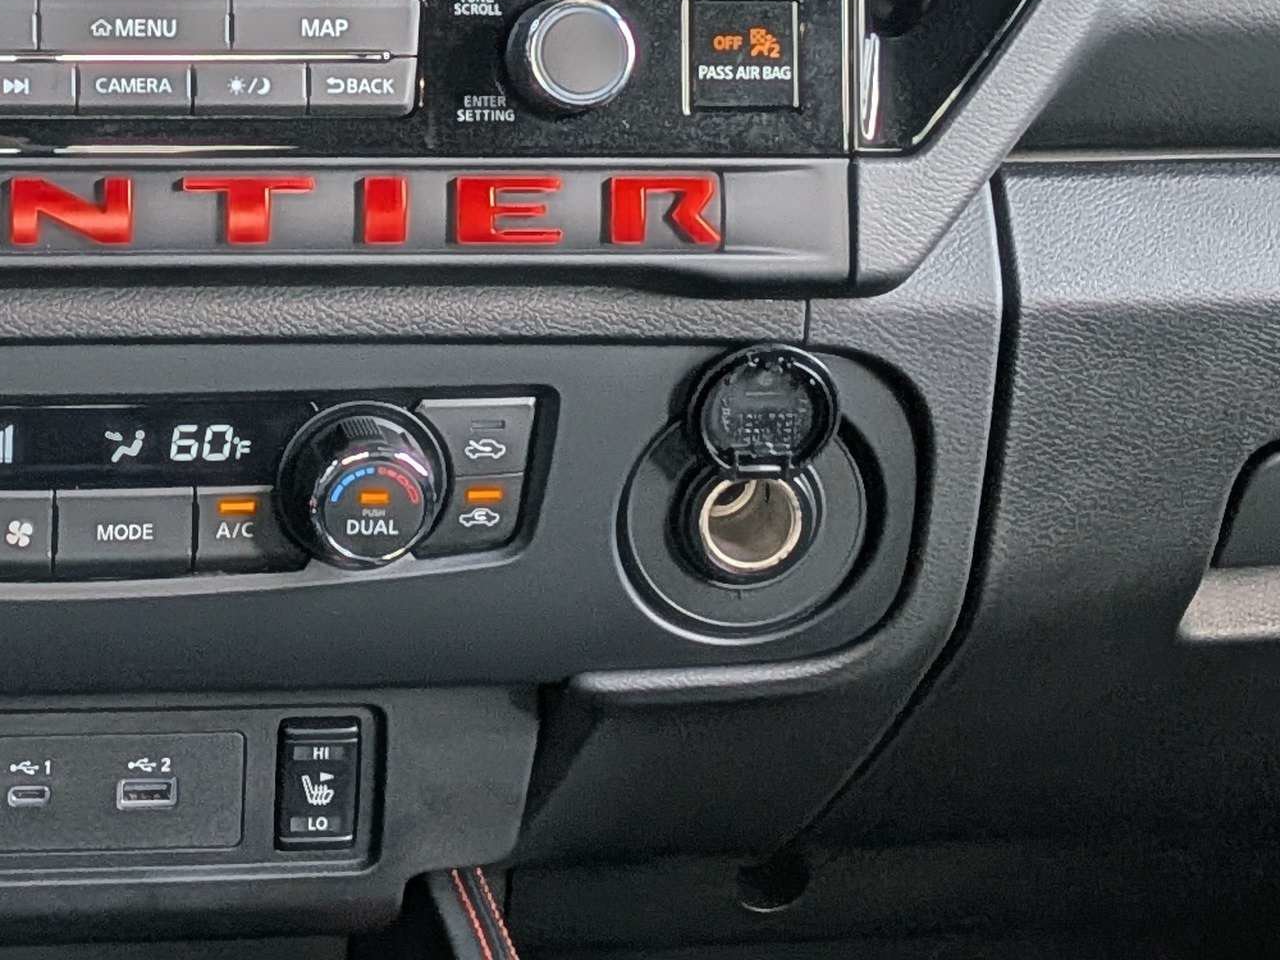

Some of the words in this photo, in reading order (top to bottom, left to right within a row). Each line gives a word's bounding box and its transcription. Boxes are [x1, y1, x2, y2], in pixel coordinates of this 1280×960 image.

[454, 4, 502, 16] SCROLL
[116, 19, 177, 37] MENU
[301, 19, 348, 37] MAP
[714, 36, 743, 50] OFF
[698, 65, 733, 80] PASS
[736, 65, 760, 79] AIR
[763, 65, 791, 80] BAG
[95, 78, 172, 94] CAMERA
[348, 78, 394, 95] BACK
[464, 96, 506, 108] ENTER
[457, 110, 515, 122] SETTING
[362, 508, 386, 518] PUSH
[96, 524, 154, 541] MODE
[215, 521, 255, 539] A/C
[345, 519, 399, 537] DUAL
[313, 747, 329, 760] HI
[44, 760, 52, 775] 1
[160, 757, 171, 773] 2
[308, 817, 328, 831] LO
